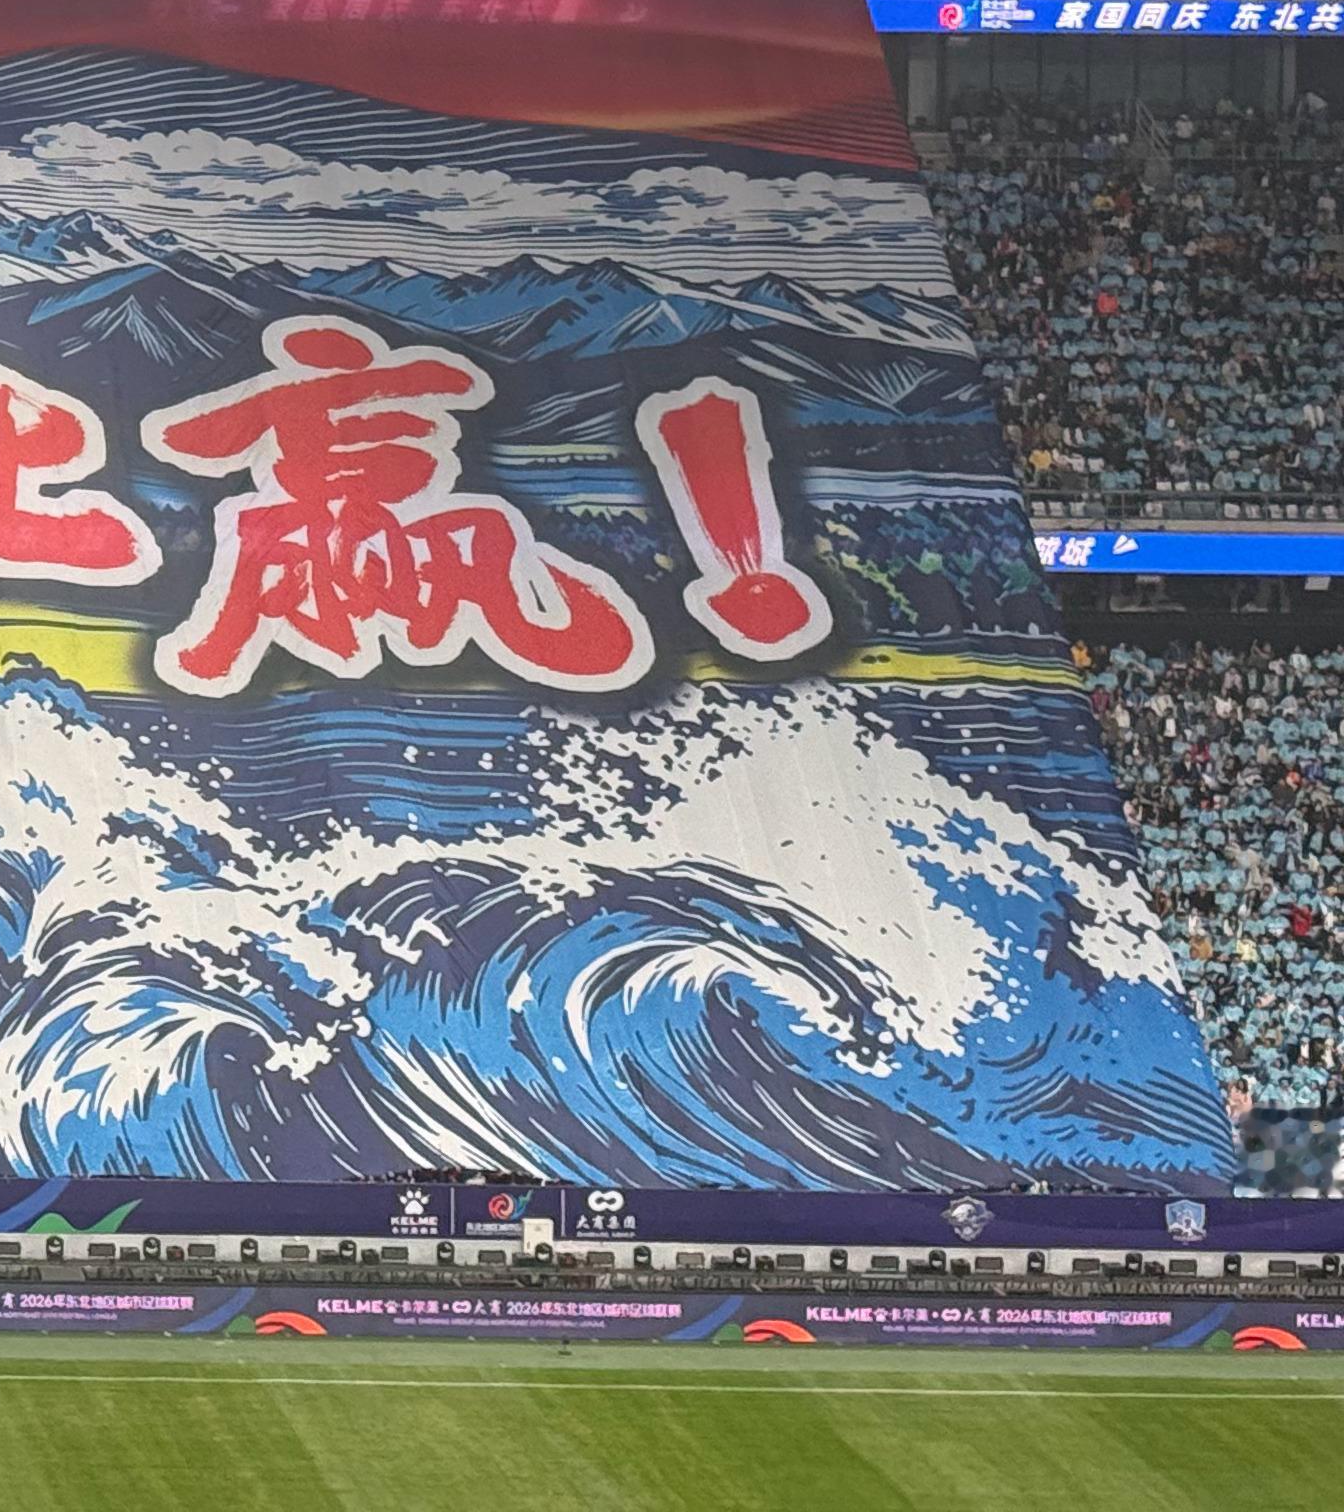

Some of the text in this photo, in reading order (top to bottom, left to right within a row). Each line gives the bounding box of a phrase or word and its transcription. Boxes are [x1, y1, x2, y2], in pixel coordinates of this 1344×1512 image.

[1055, 1, 1209, 30] 家国同庆
[390, 1216, 438, 1226] KELME
[318, 1299, 383, 1314] KELME
[806, 1306, 873, 1322] KELME
